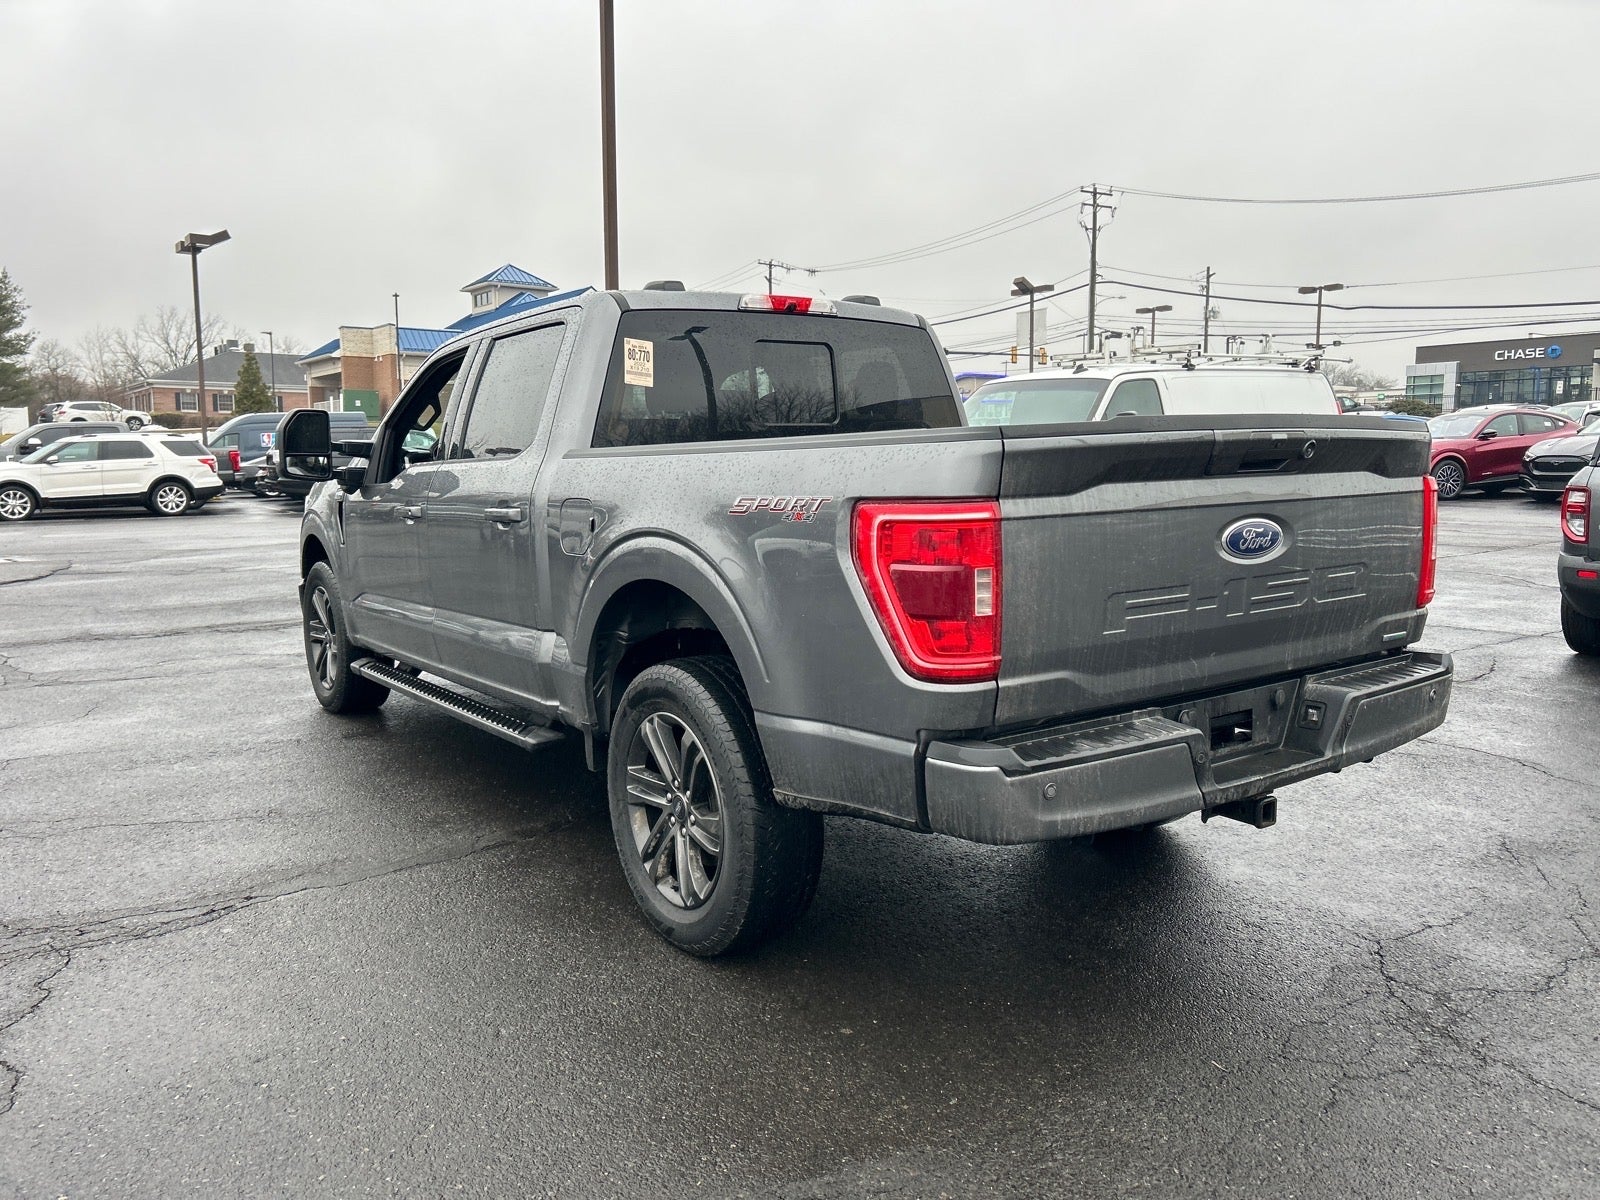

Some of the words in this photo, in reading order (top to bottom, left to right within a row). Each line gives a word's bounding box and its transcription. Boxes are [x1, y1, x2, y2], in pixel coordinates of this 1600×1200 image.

[1494, 347, 1545, 360] CHASE
[728, 496, 833, 515] SPORT
[1239, 527, 1273, 550] Ford
[1102, 561, 1369, 636] F-150
